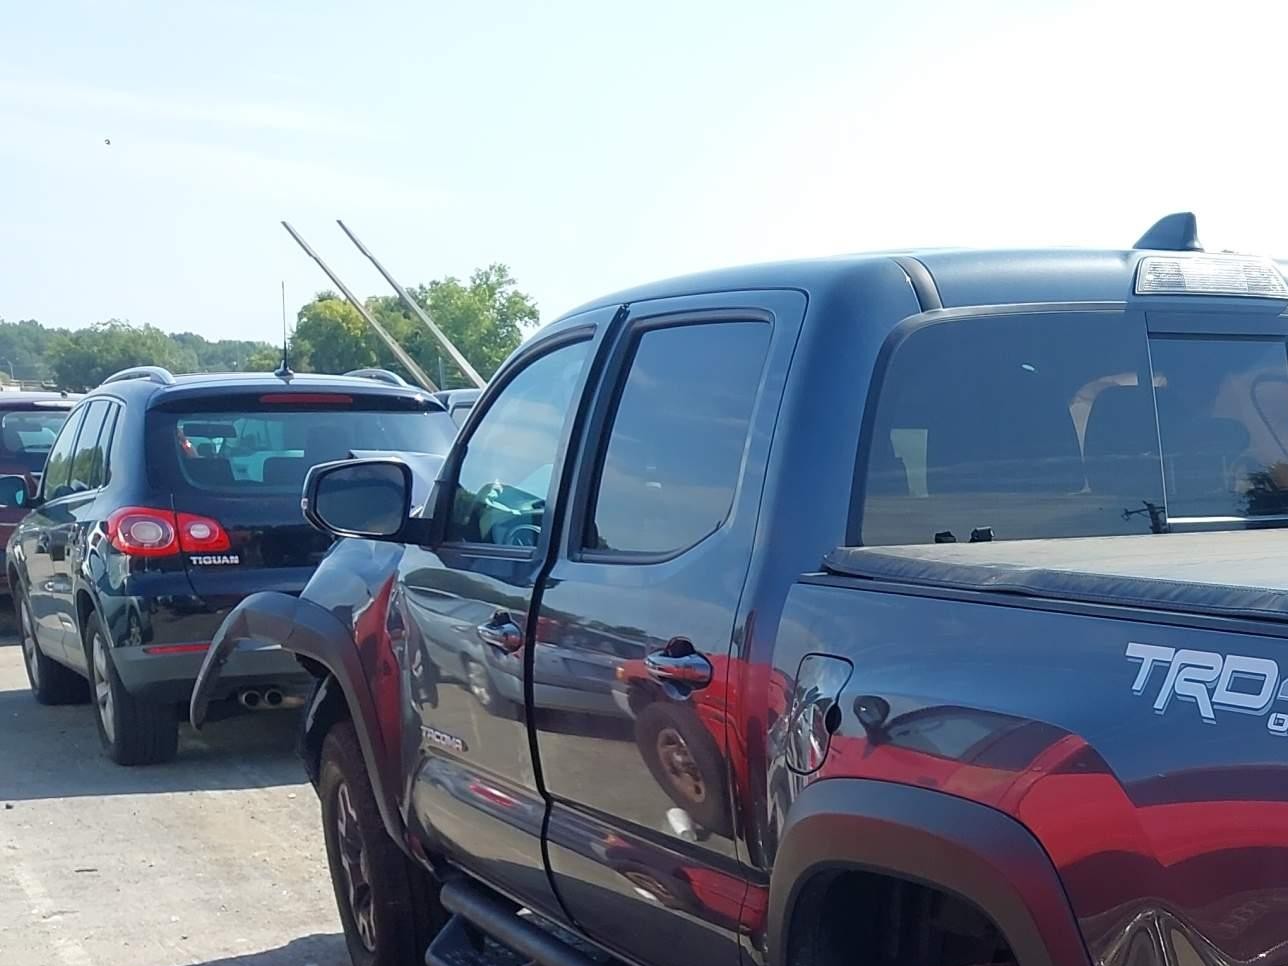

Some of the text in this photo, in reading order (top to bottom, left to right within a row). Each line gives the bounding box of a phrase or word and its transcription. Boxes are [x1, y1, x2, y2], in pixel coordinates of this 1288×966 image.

[189, 555, 240, 565] TIGUAN
[1126, 643, 1280, 724] TRD
[421, 726, 464, 752] TACOMA
